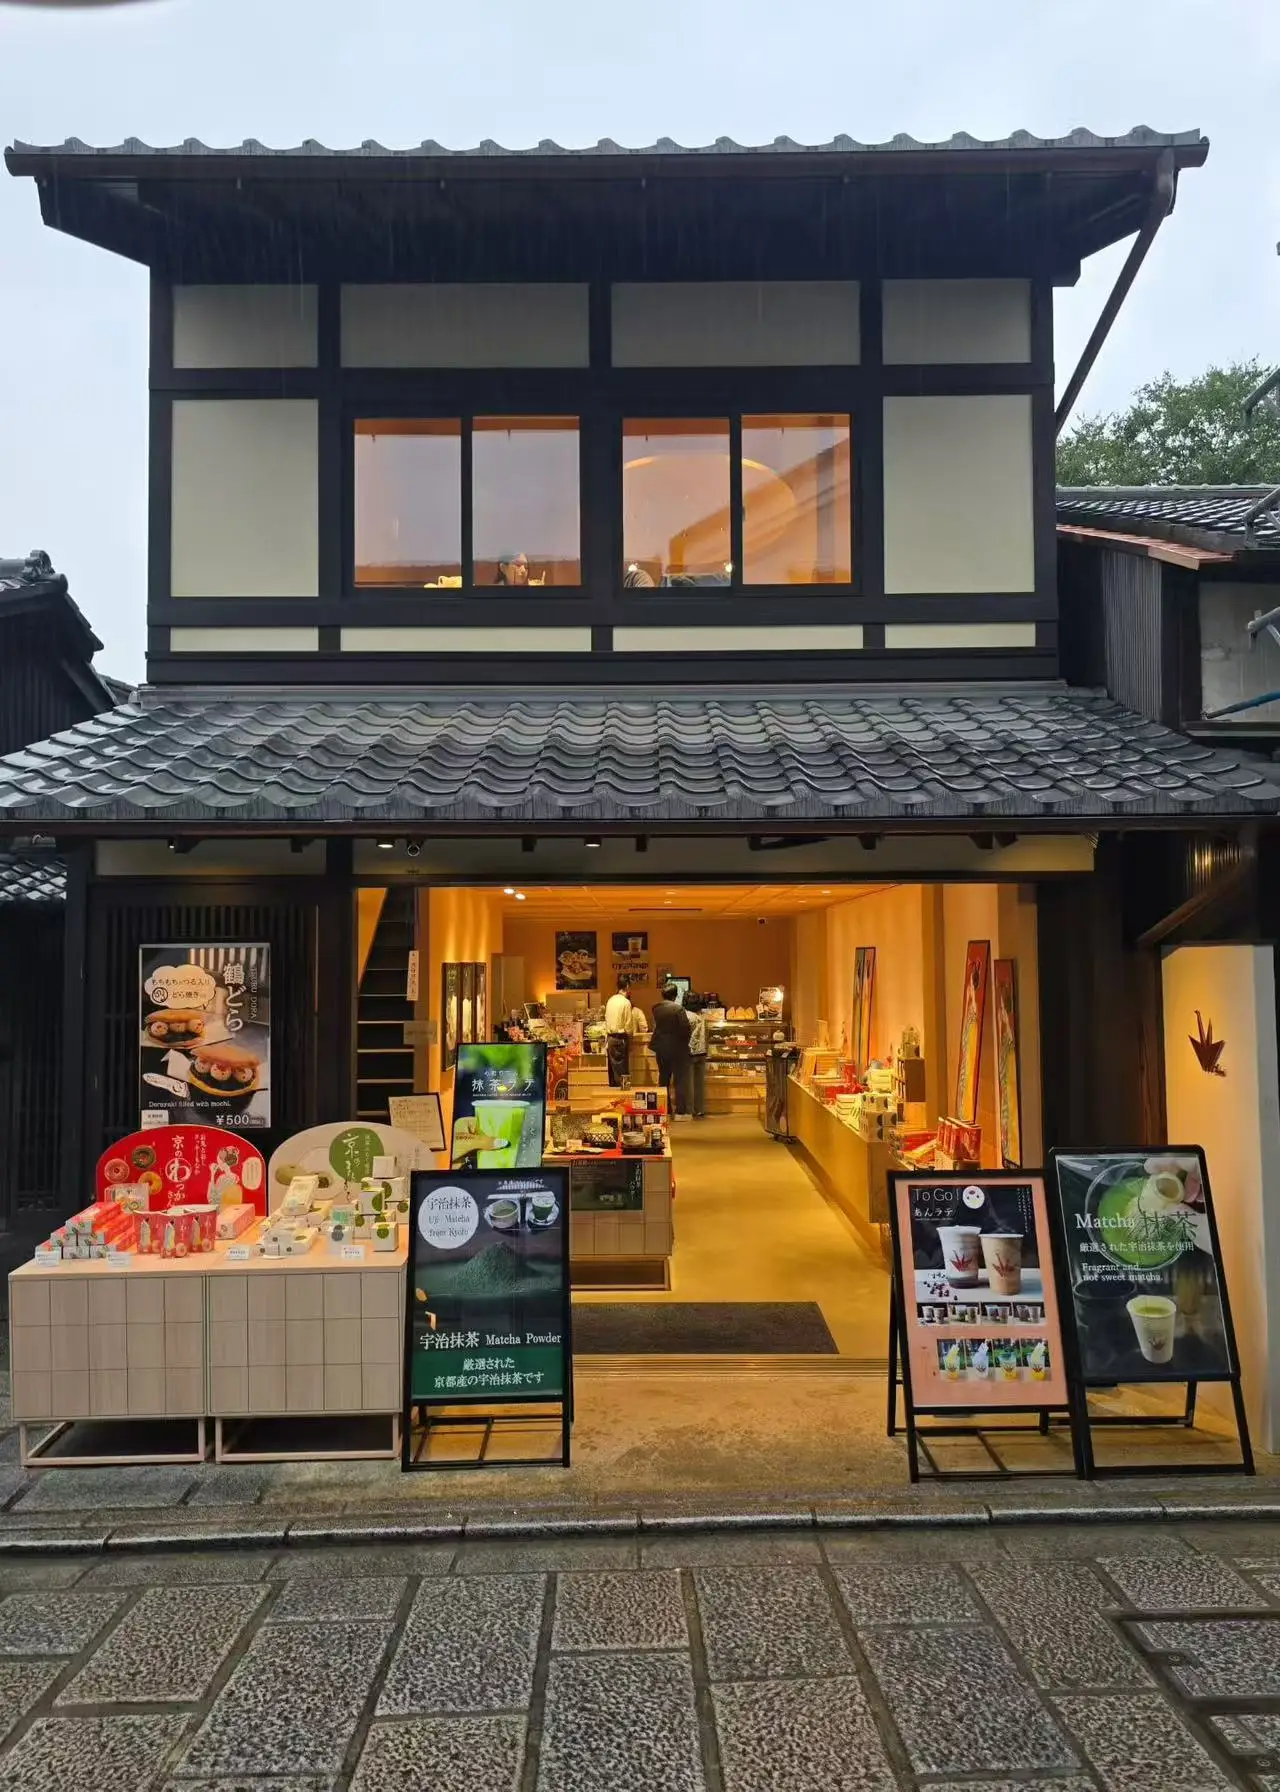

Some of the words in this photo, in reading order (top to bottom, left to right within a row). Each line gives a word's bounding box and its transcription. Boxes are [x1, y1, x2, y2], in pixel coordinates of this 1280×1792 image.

[250, 995, 258, 1019] DORA
[216, 1114, 250, 1125] ¥500
[912, 1188, 931, 1201] To
[428, 1196, 471, 1211] 宇治抹茶
[445, 1214, 470, 1223] Matcha
[914, 1208, 953, 1217] あんラテ
[1074, 1212, 1135, 1229] Matcha
[1081, 1262, 1120, 1273] Fragrant
[1122, 1262, 1140, 1271] and
[1082, 1273, 1099, 1281] not
[1101, 1273, 1126, 1281] sweet
[420, 1331, 480, 1350] 宇治抹茶
[486, 1334, 521, 1346] Matcha
[526, 1332, 561, 1344] Powder
[463, 1357, 515, 1371] 厳選された
[434, 1371, 545, 1389] 京都産の宇治抹茶です
